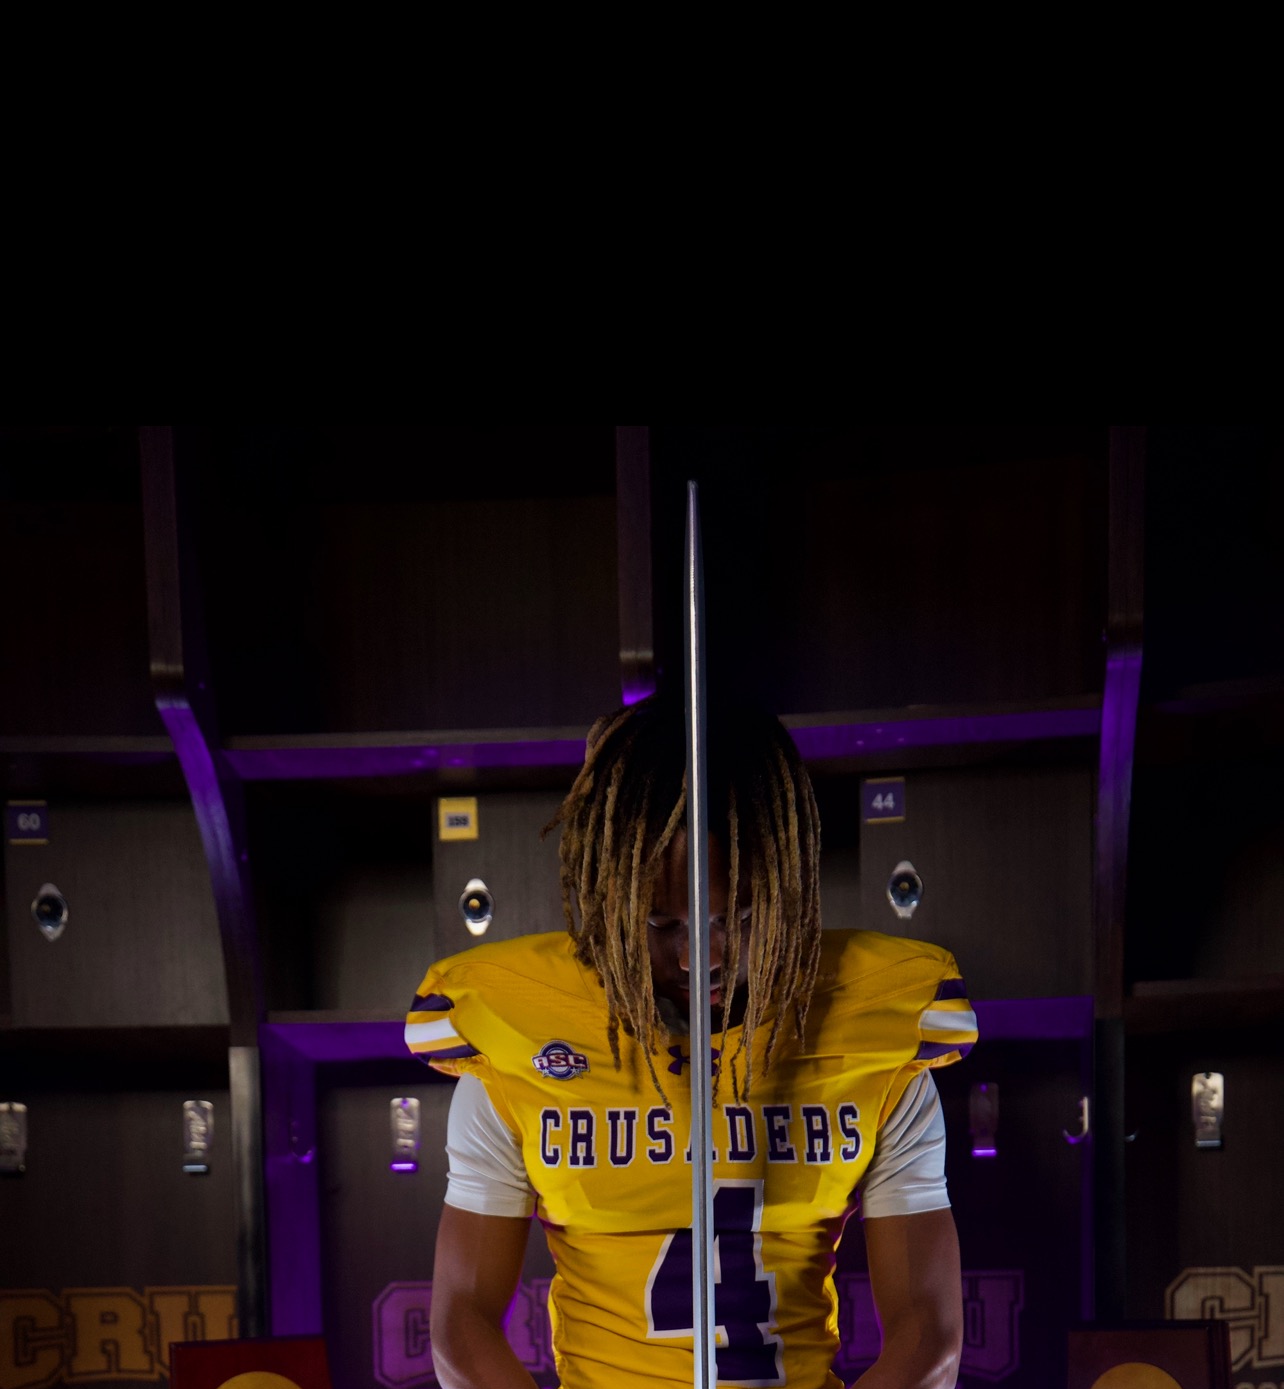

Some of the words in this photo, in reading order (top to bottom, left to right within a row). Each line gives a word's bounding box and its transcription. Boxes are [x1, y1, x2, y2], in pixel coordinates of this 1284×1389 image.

[871, 792, 895, 811] 44
[17, 812, 41, 832] 60
[533, 1054, 586, 1069] ASC
[644, 1178, 786, 1387] 4
